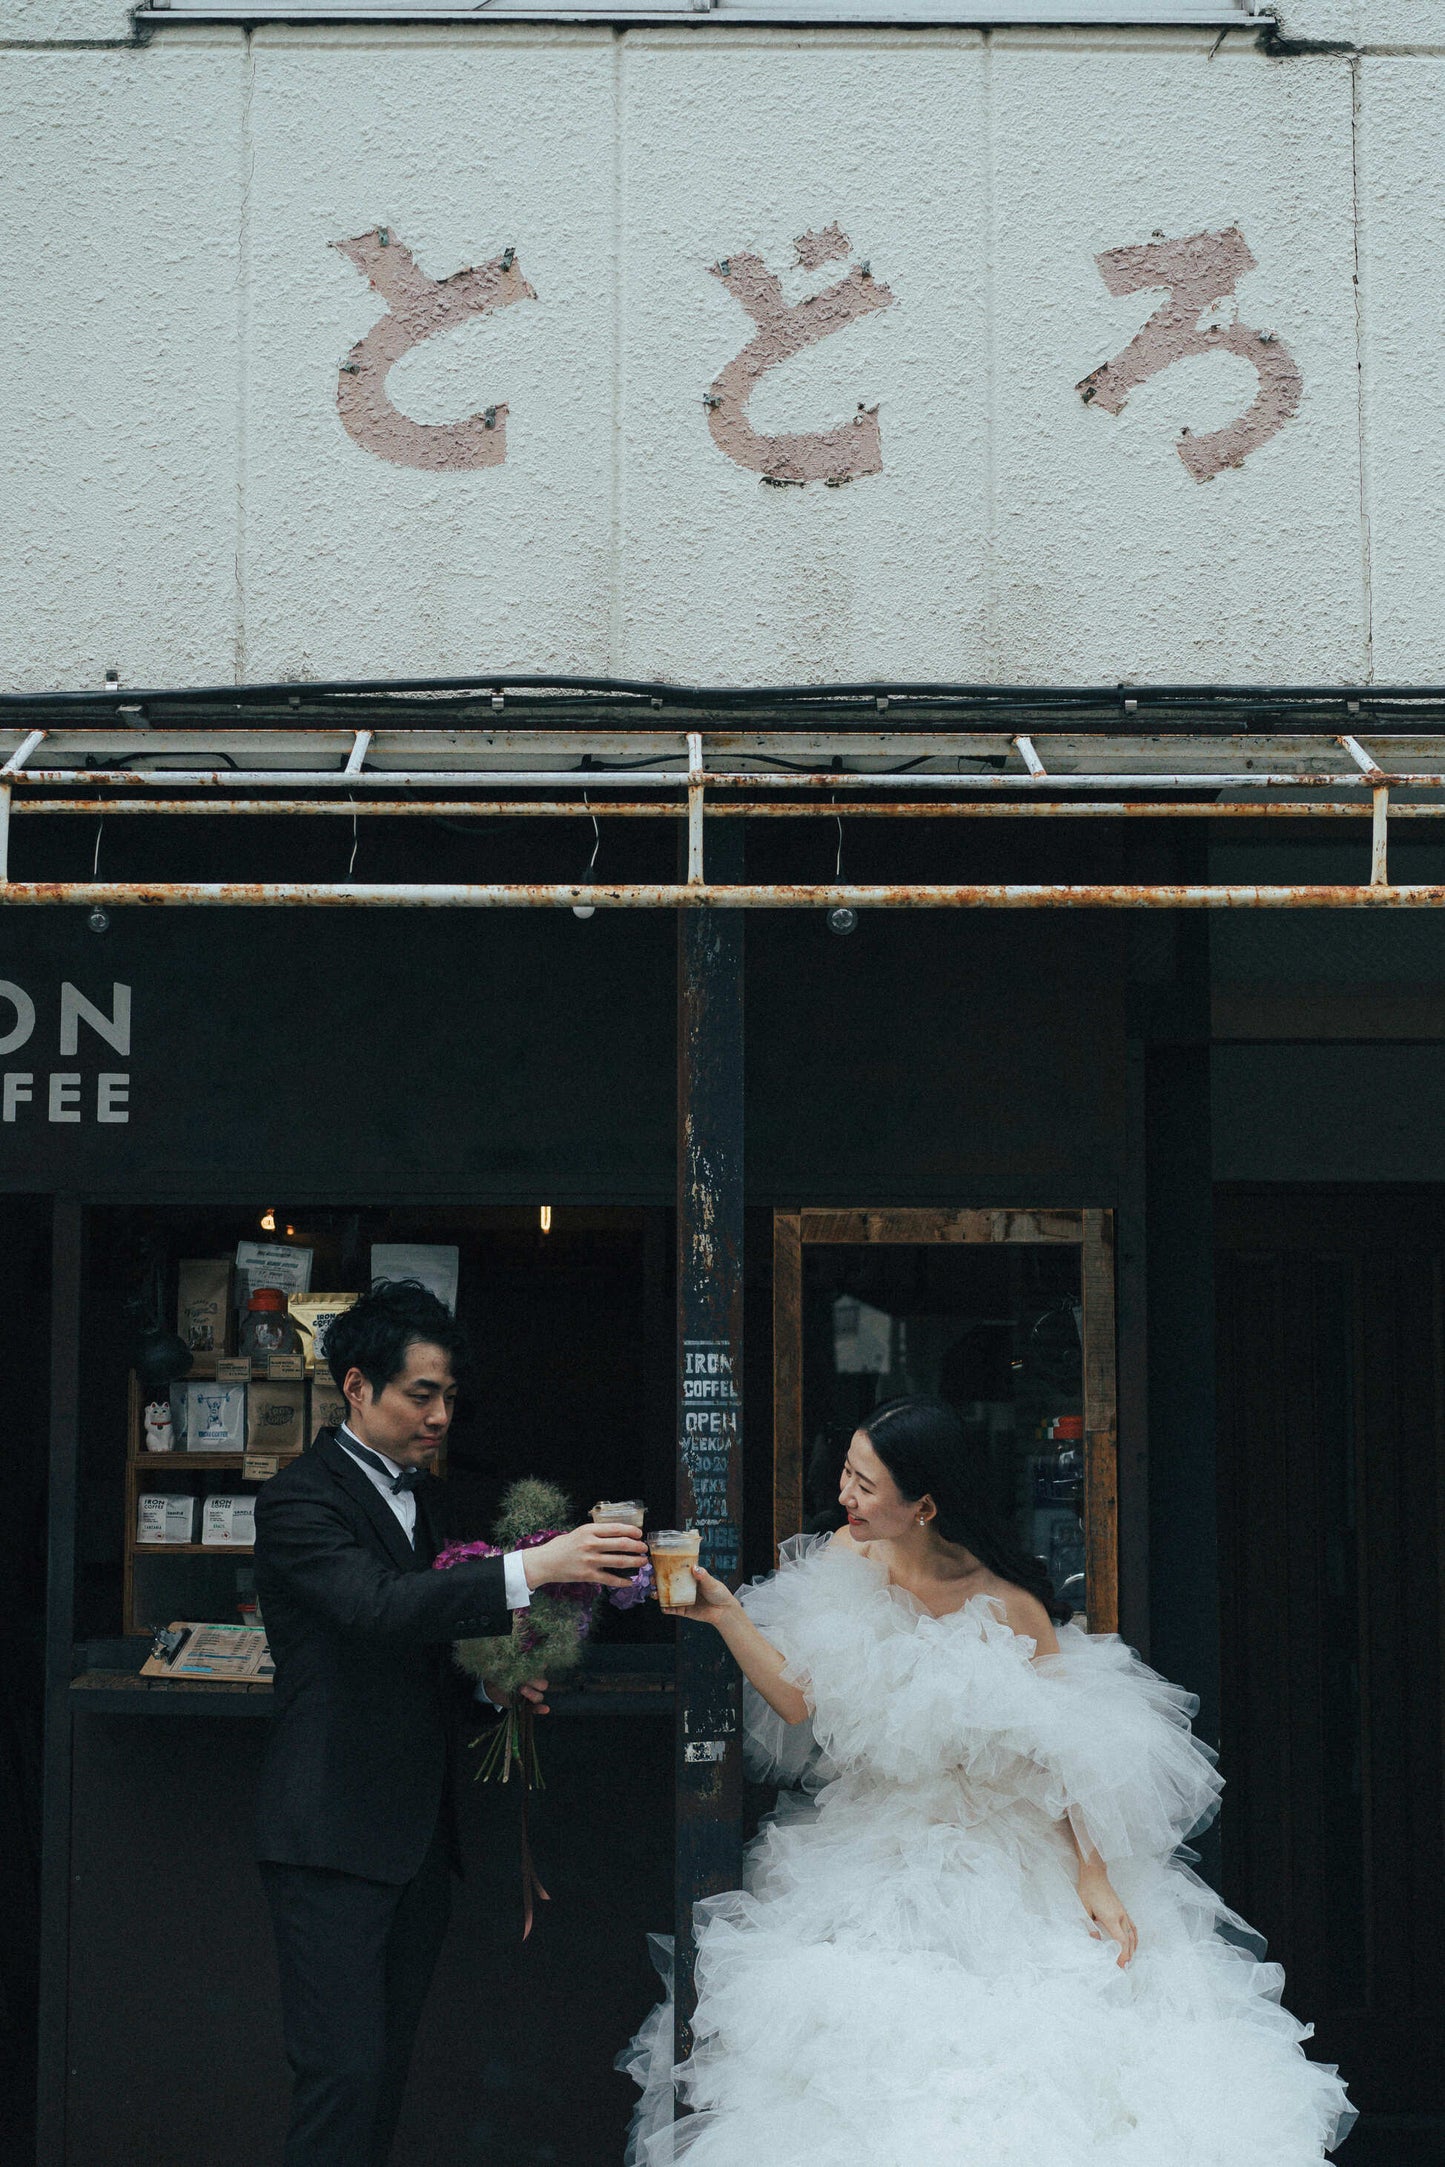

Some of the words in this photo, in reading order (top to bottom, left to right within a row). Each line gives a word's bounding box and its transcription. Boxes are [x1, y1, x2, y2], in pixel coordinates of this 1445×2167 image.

[328, 220, 1303, 486] とどろ
[2, 1072, 131, 1124] FEE
[316, 1312, 336, 1320] IRON
[685, 1352, 735, 1374] IRON
[685, 1411, 737, 1433] OPEN
